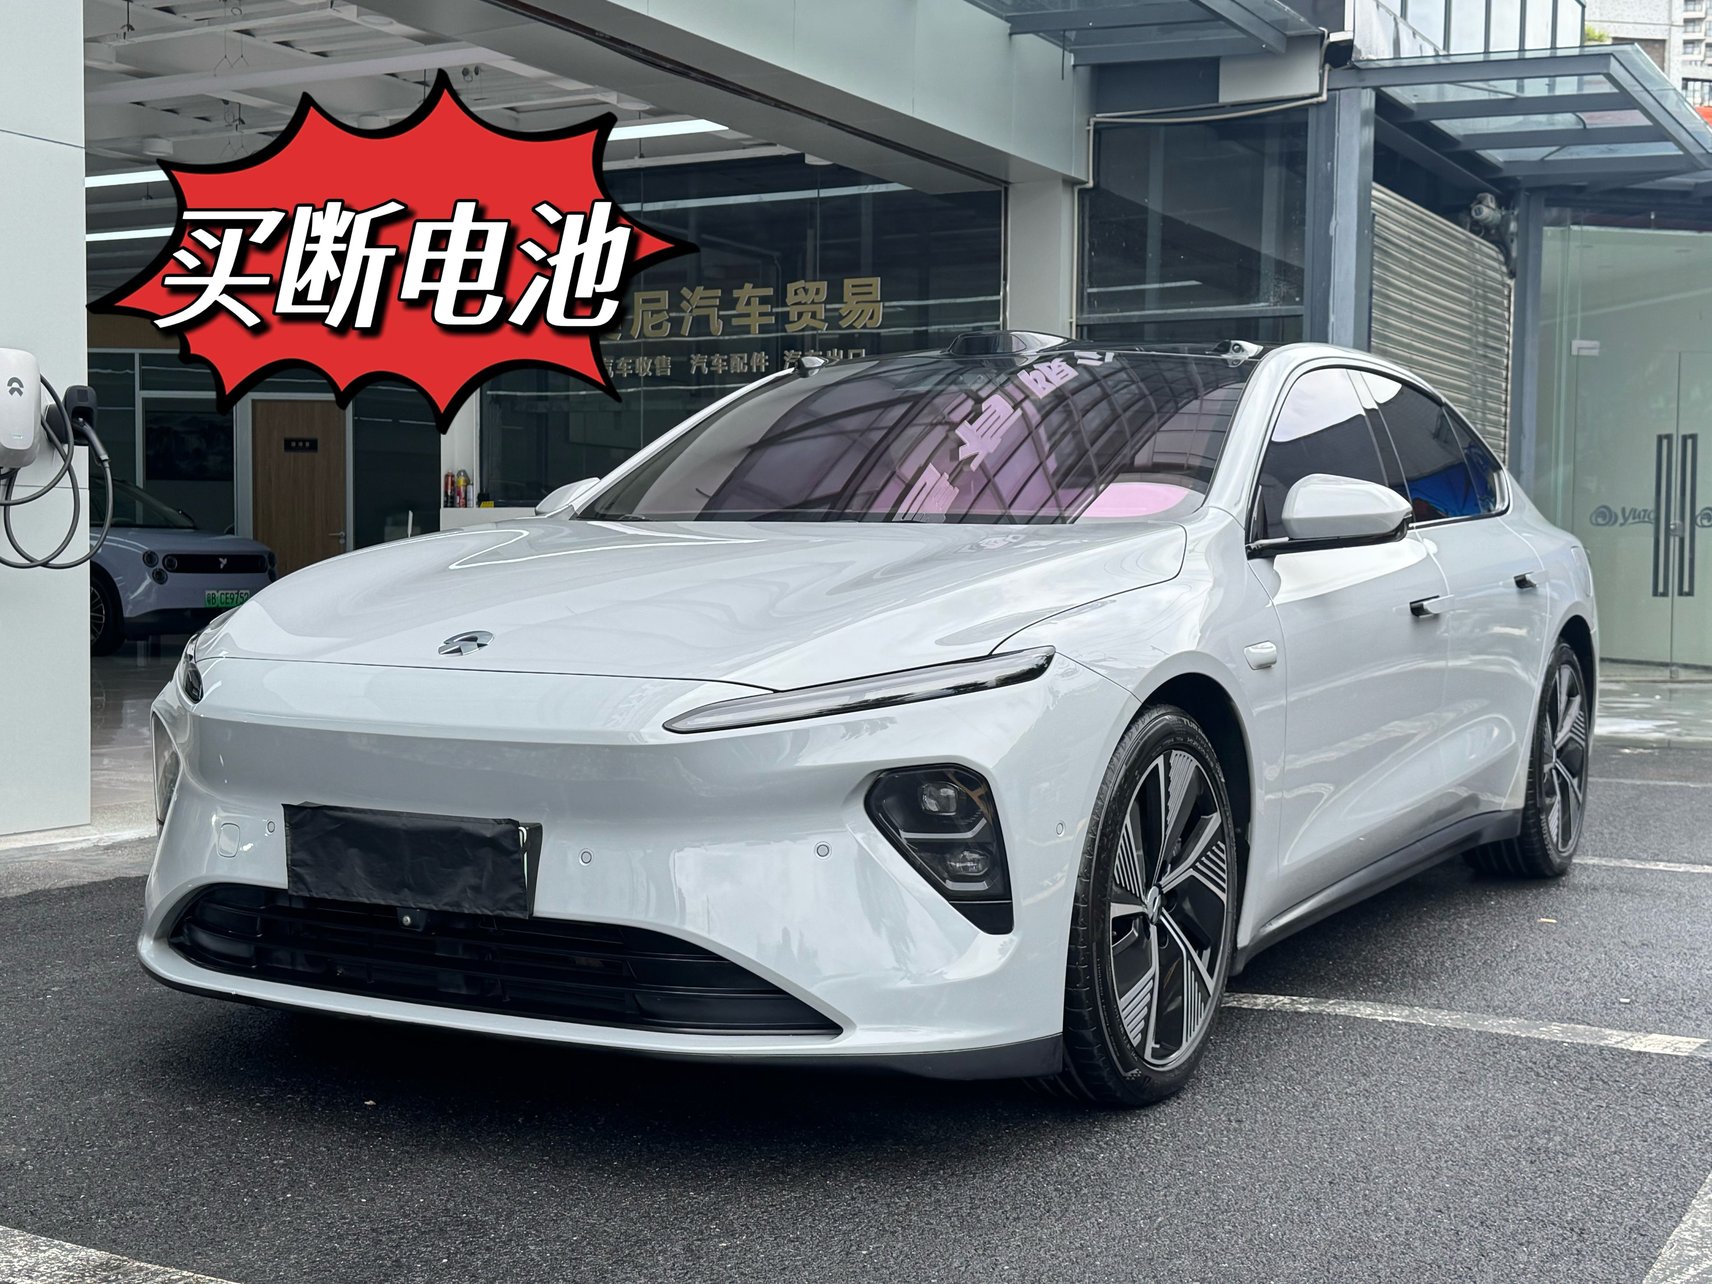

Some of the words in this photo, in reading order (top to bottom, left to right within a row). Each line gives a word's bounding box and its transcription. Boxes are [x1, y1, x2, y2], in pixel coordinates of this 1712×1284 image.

[607, 277, 884, 340] 尼汽车贸易
[690, 351, 769, 374] 汽车配件
